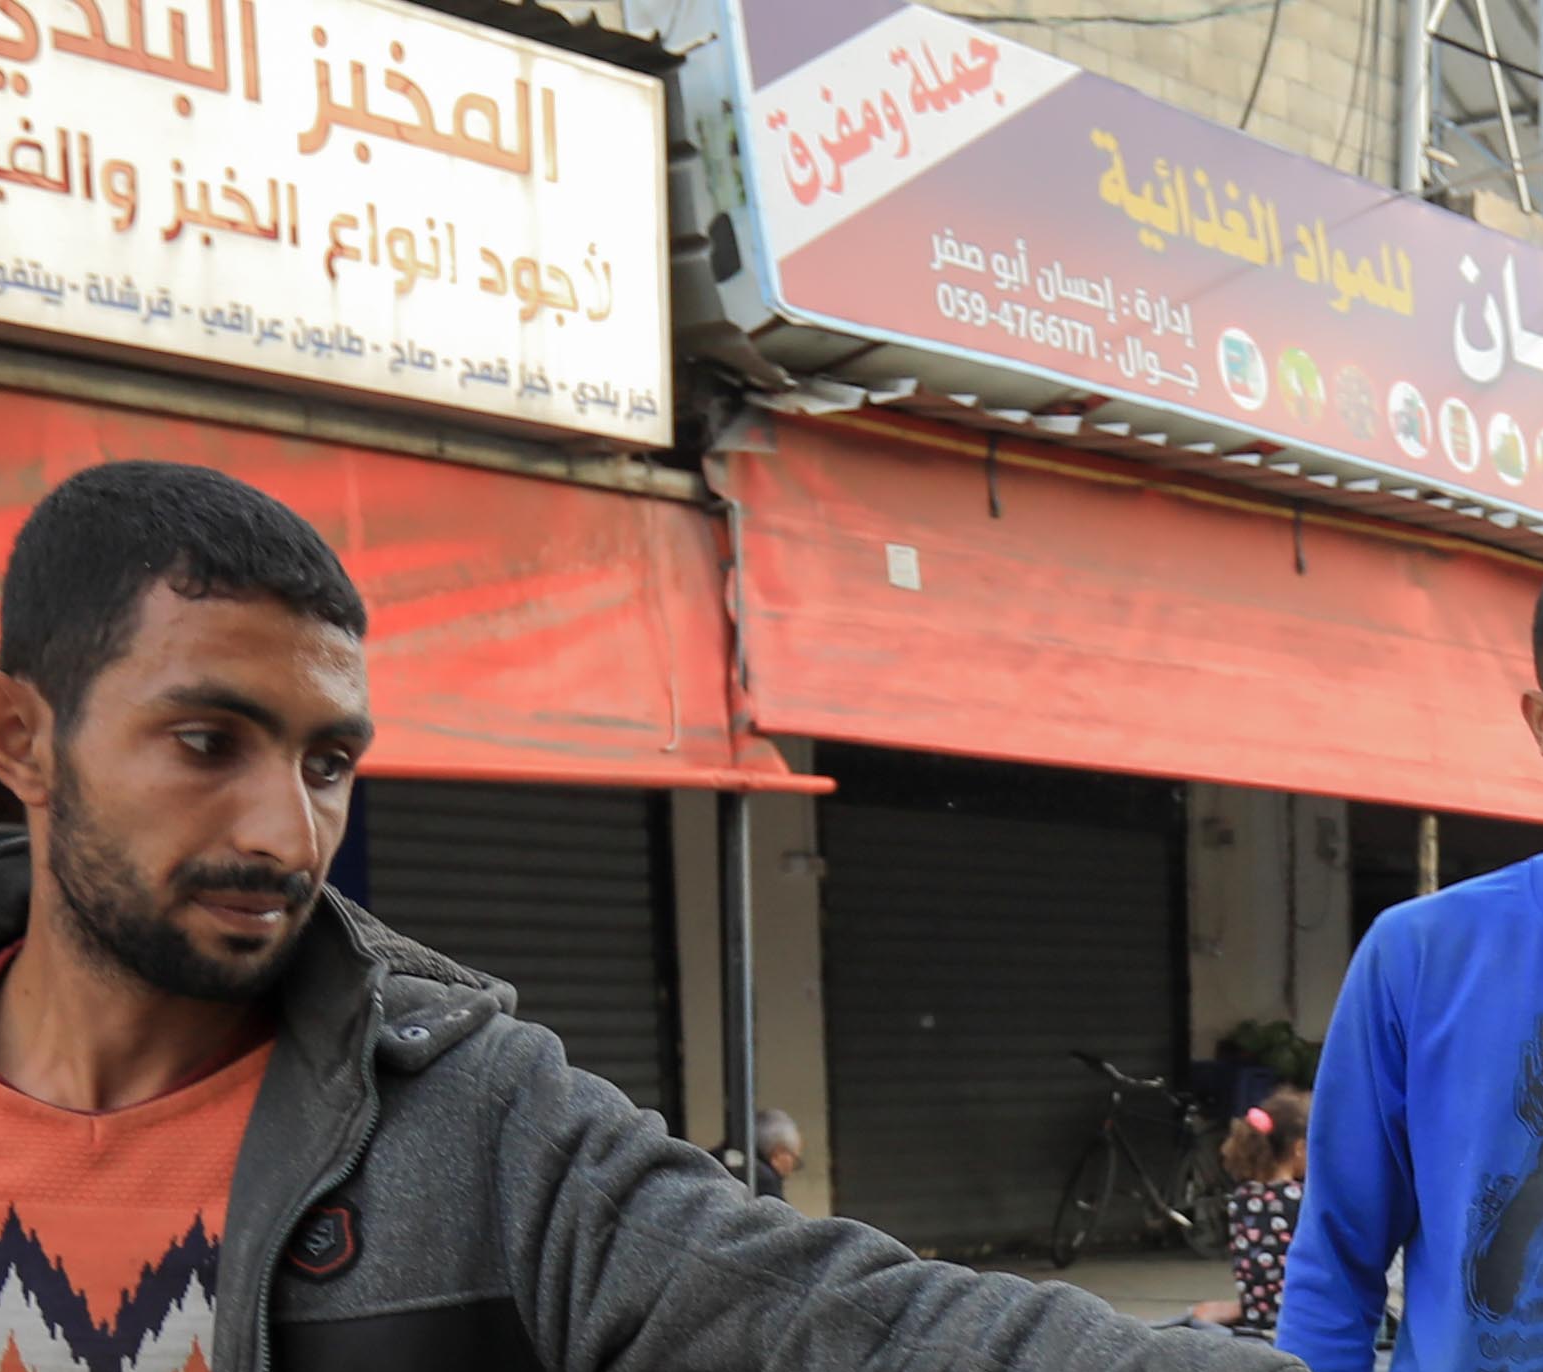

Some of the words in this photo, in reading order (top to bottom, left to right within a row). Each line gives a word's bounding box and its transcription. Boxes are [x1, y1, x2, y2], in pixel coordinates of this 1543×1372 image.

[297, 25, 559, 183] المخبز
[889, 37, 1006, 115] جملة
[765, 84, 911, 207] ومفرق
[160, 159, 299, 247] الخبز
[1089, 128, 1283, 268] الغذائية
[930, 227, 985, 271] صفر
[990, 237, 1030, 292] أبو
[1292, 217, 1415, 317] للمواد
[199, 298, 284, 345] عراقي
[1035, 260, 1118, 324] إحسان
[1133, 286, 1196, 349] إدارة
[292, 317, 364, 360] طابون
[570, 383, 619, 412] بلدي
